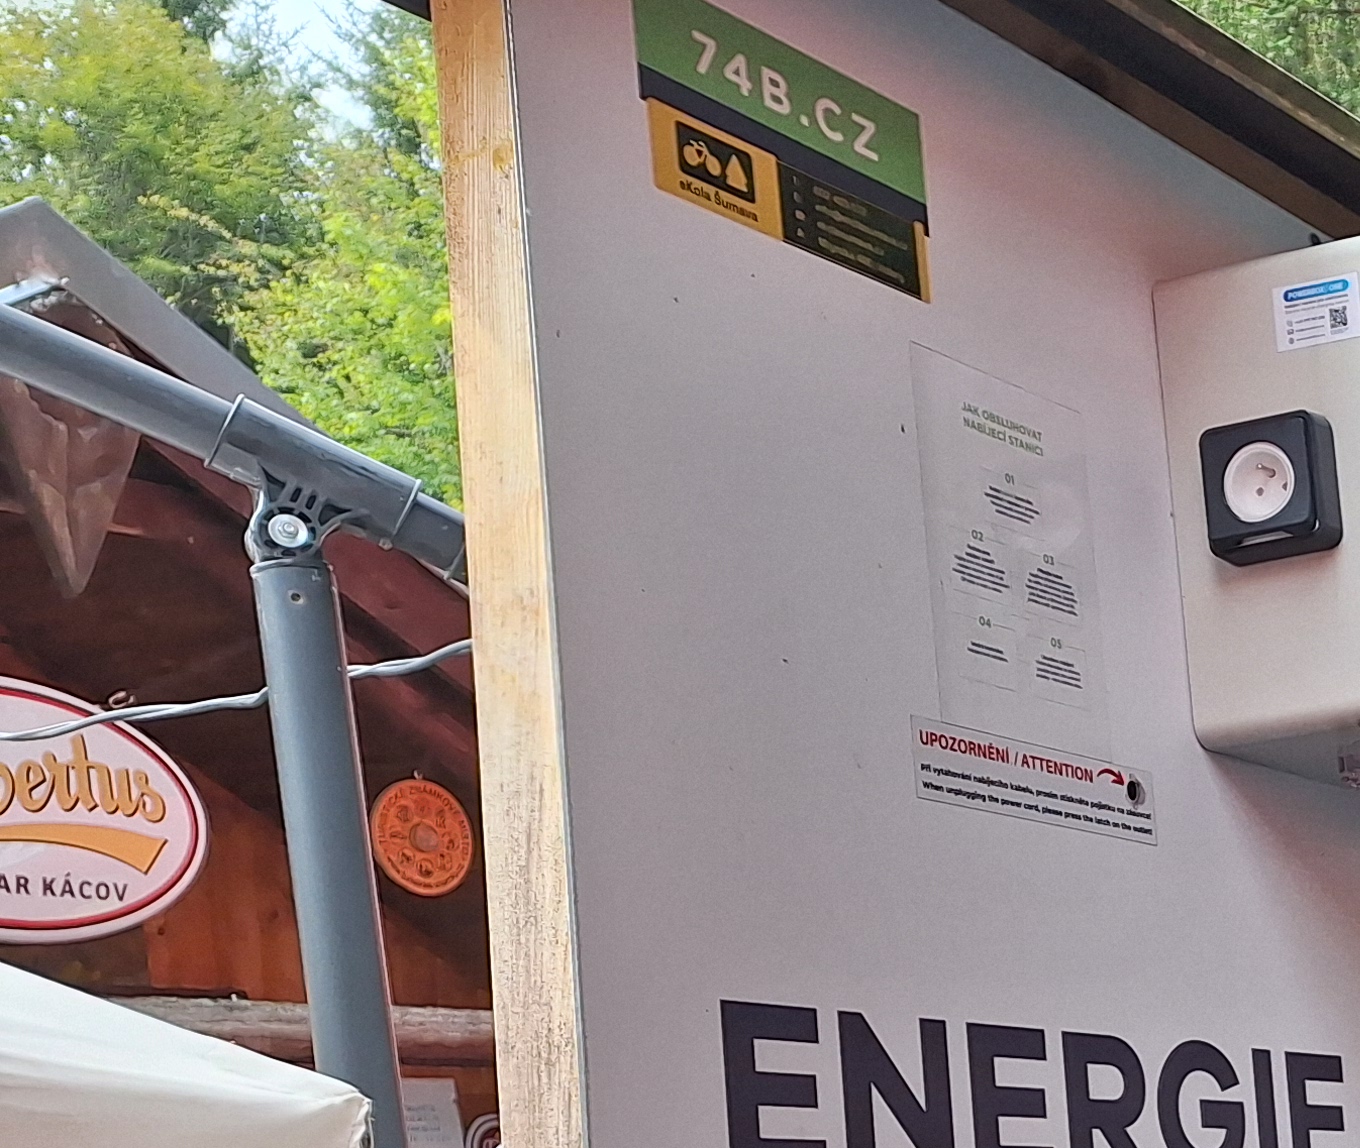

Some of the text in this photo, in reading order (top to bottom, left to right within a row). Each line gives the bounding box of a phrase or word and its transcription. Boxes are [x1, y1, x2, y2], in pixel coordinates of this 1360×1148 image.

[690, 29, 880, 163] 74B.CZ
[679, 178, 759, 223] eKola Šumava
[962, 401, 981, 418] JAK
[1004, 472, 1015, 485] 01
[971, 529, 985, 542] 02
[978, 616, 992, 629] 04
[919, 728, 1010, 764] UPOZORNĚNÍ
[1021, 753, 1094, 783] ATTENTION
[41, 871, 129, 902] KÁCOV
